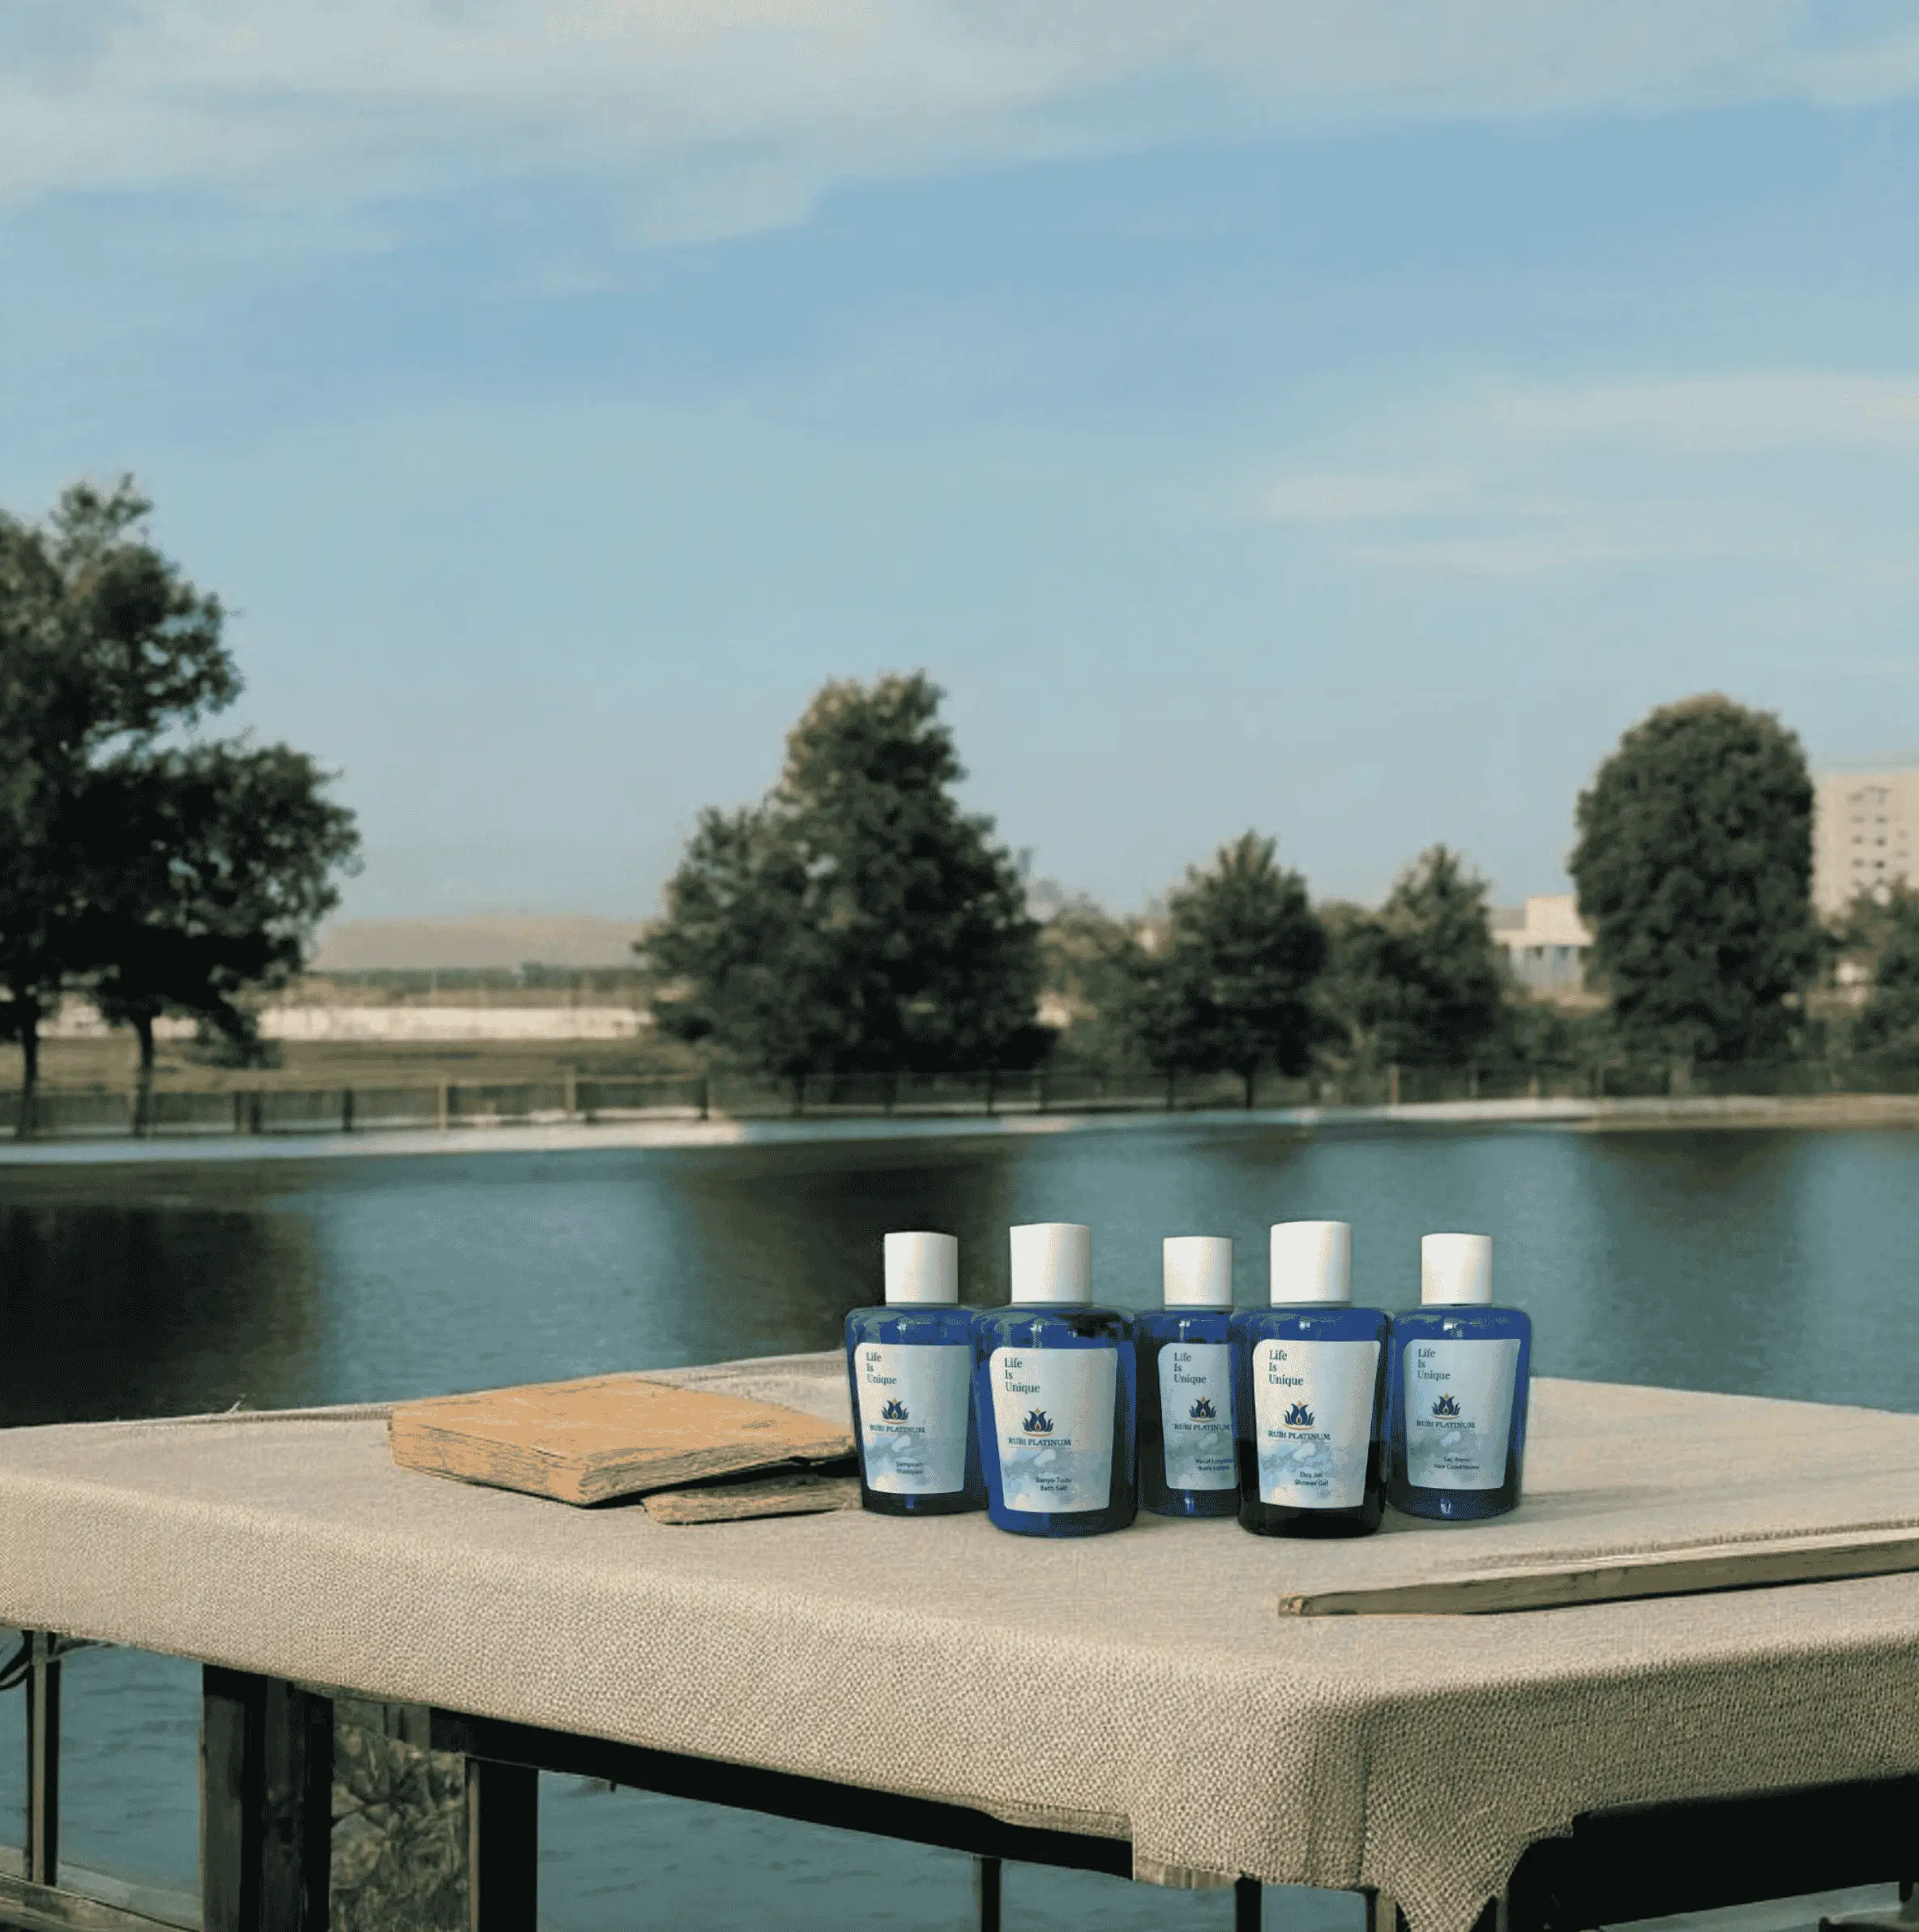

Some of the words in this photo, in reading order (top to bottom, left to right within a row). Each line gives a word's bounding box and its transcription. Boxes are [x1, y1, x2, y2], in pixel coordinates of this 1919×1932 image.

[866, 1352, 882, 1361] Life
[1173, 1352, 1191, 1361] Life
[1269, 1349, 1287, 1361] Life
[1418, 1349, 1435, 1357] Life
[866, 1362, 874, 1372] Is
[1005, 1357, 1022, 1368] Life
[1173, 1363, 1182, 1372] Is
[1269, 1361, 1277, 1372] Is
[1418, 1360, 1425, 1368] Is
[867, 1374, 897, 1385] Unique
[1005, 1370, 1013, 1379] Is
[1173, 1374, 1207, 1385] Unique
[1418, 1370, 1451, 1381] Unique
[1269, 1374, 1304, 1387] Unique
[1006, 1382, 1040, 1394] Unique
[1288, 1432, 1331, 1440] PLATINUM
